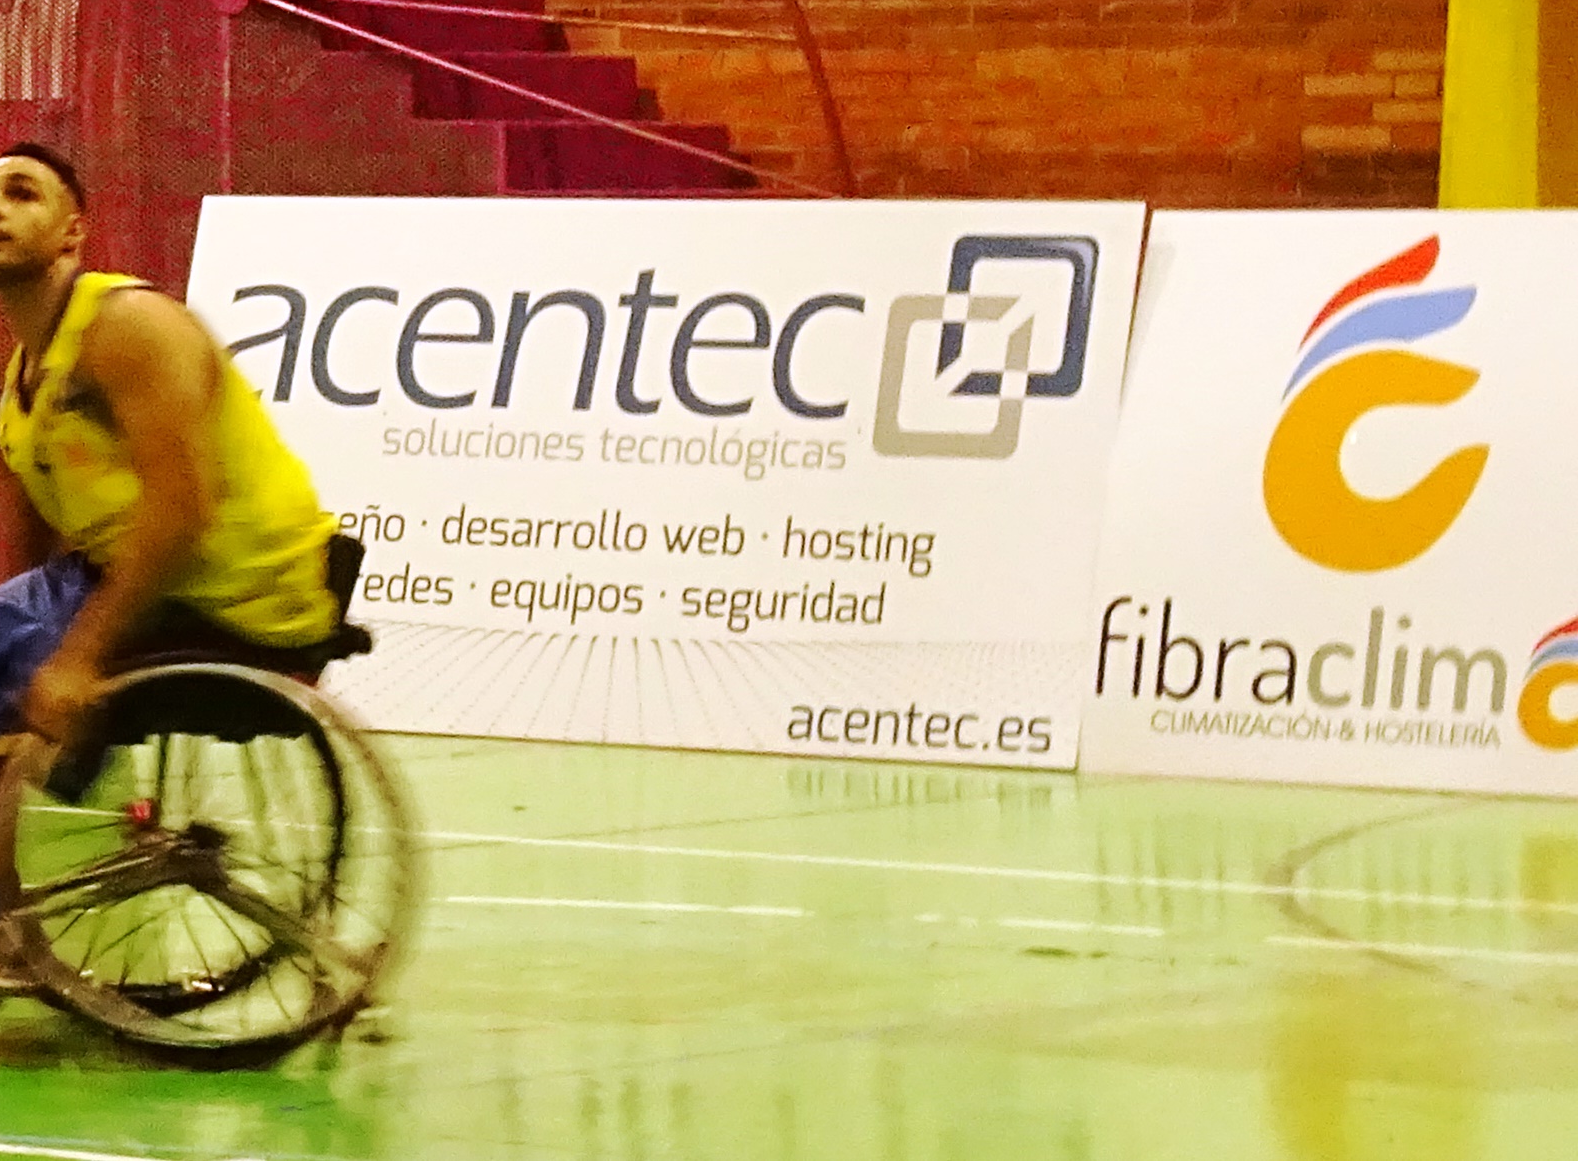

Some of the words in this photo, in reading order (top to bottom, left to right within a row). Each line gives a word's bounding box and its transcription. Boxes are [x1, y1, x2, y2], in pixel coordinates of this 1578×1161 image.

[224, 268, 865, 420] acentec
[382, 419, 584, 464] soluciones
[600, 426, 847, 481] tecnológicas
[334, 505, 406, 543] eño
[442, 503, 648, 552] desarrollo
[663, 516, 746, 556] web
[782, 517, 936, 578] hosting
[359, 562, 455, 606] edes
[491, 573, 643, 625] equipos
[681, 581, 886, 633] seguridad
[1096, 596, 1508, 714] fibraclim
[786, 699, 1053, 754] acentec.es
[1150, 707, 1331, 741] CLIMATIZACIÓN
[1339, 717, 1356, 740] &
[1364, 721, 1503, 749] HOSTELERÍA
